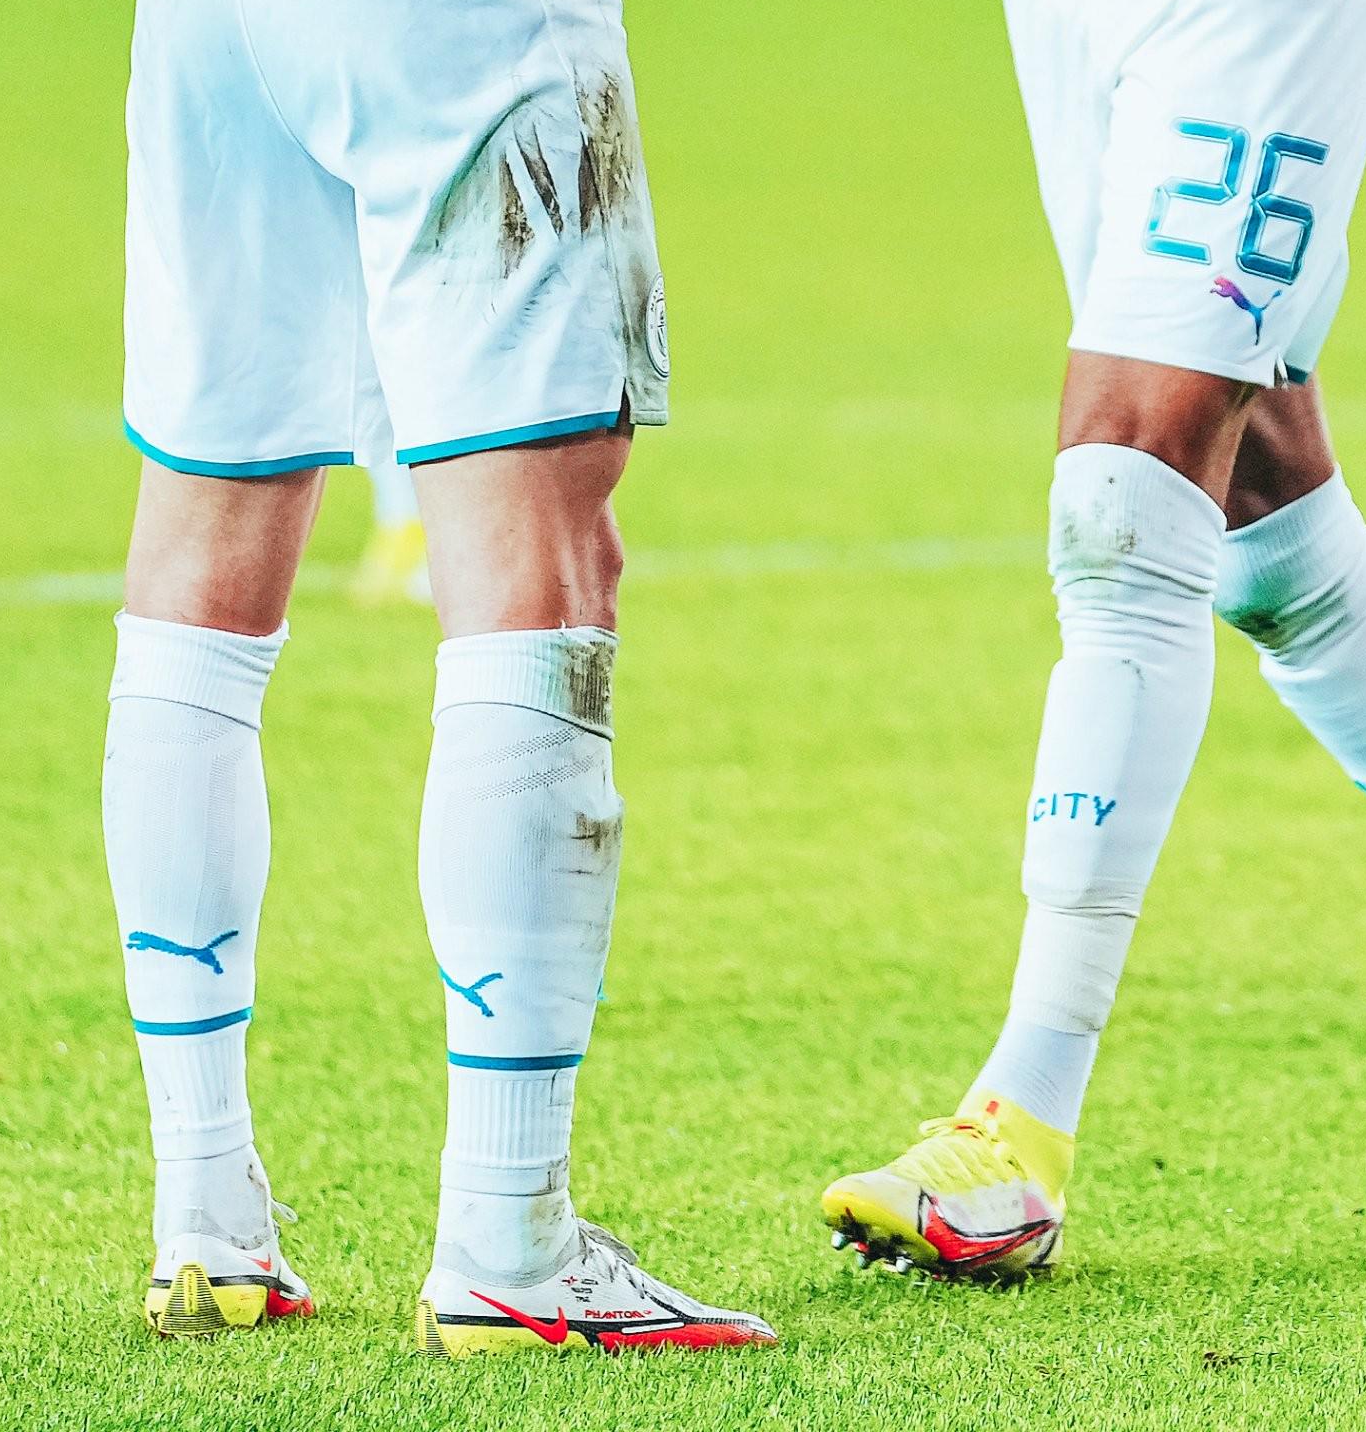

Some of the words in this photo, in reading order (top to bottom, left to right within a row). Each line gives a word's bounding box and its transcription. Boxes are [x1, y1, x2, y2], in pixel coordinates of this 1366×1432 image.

[1143, 116, 1331, 286] 26
[1033, 792, 1116, 826] CITY
[584, 1309, 645, 1320] PHANTOM
